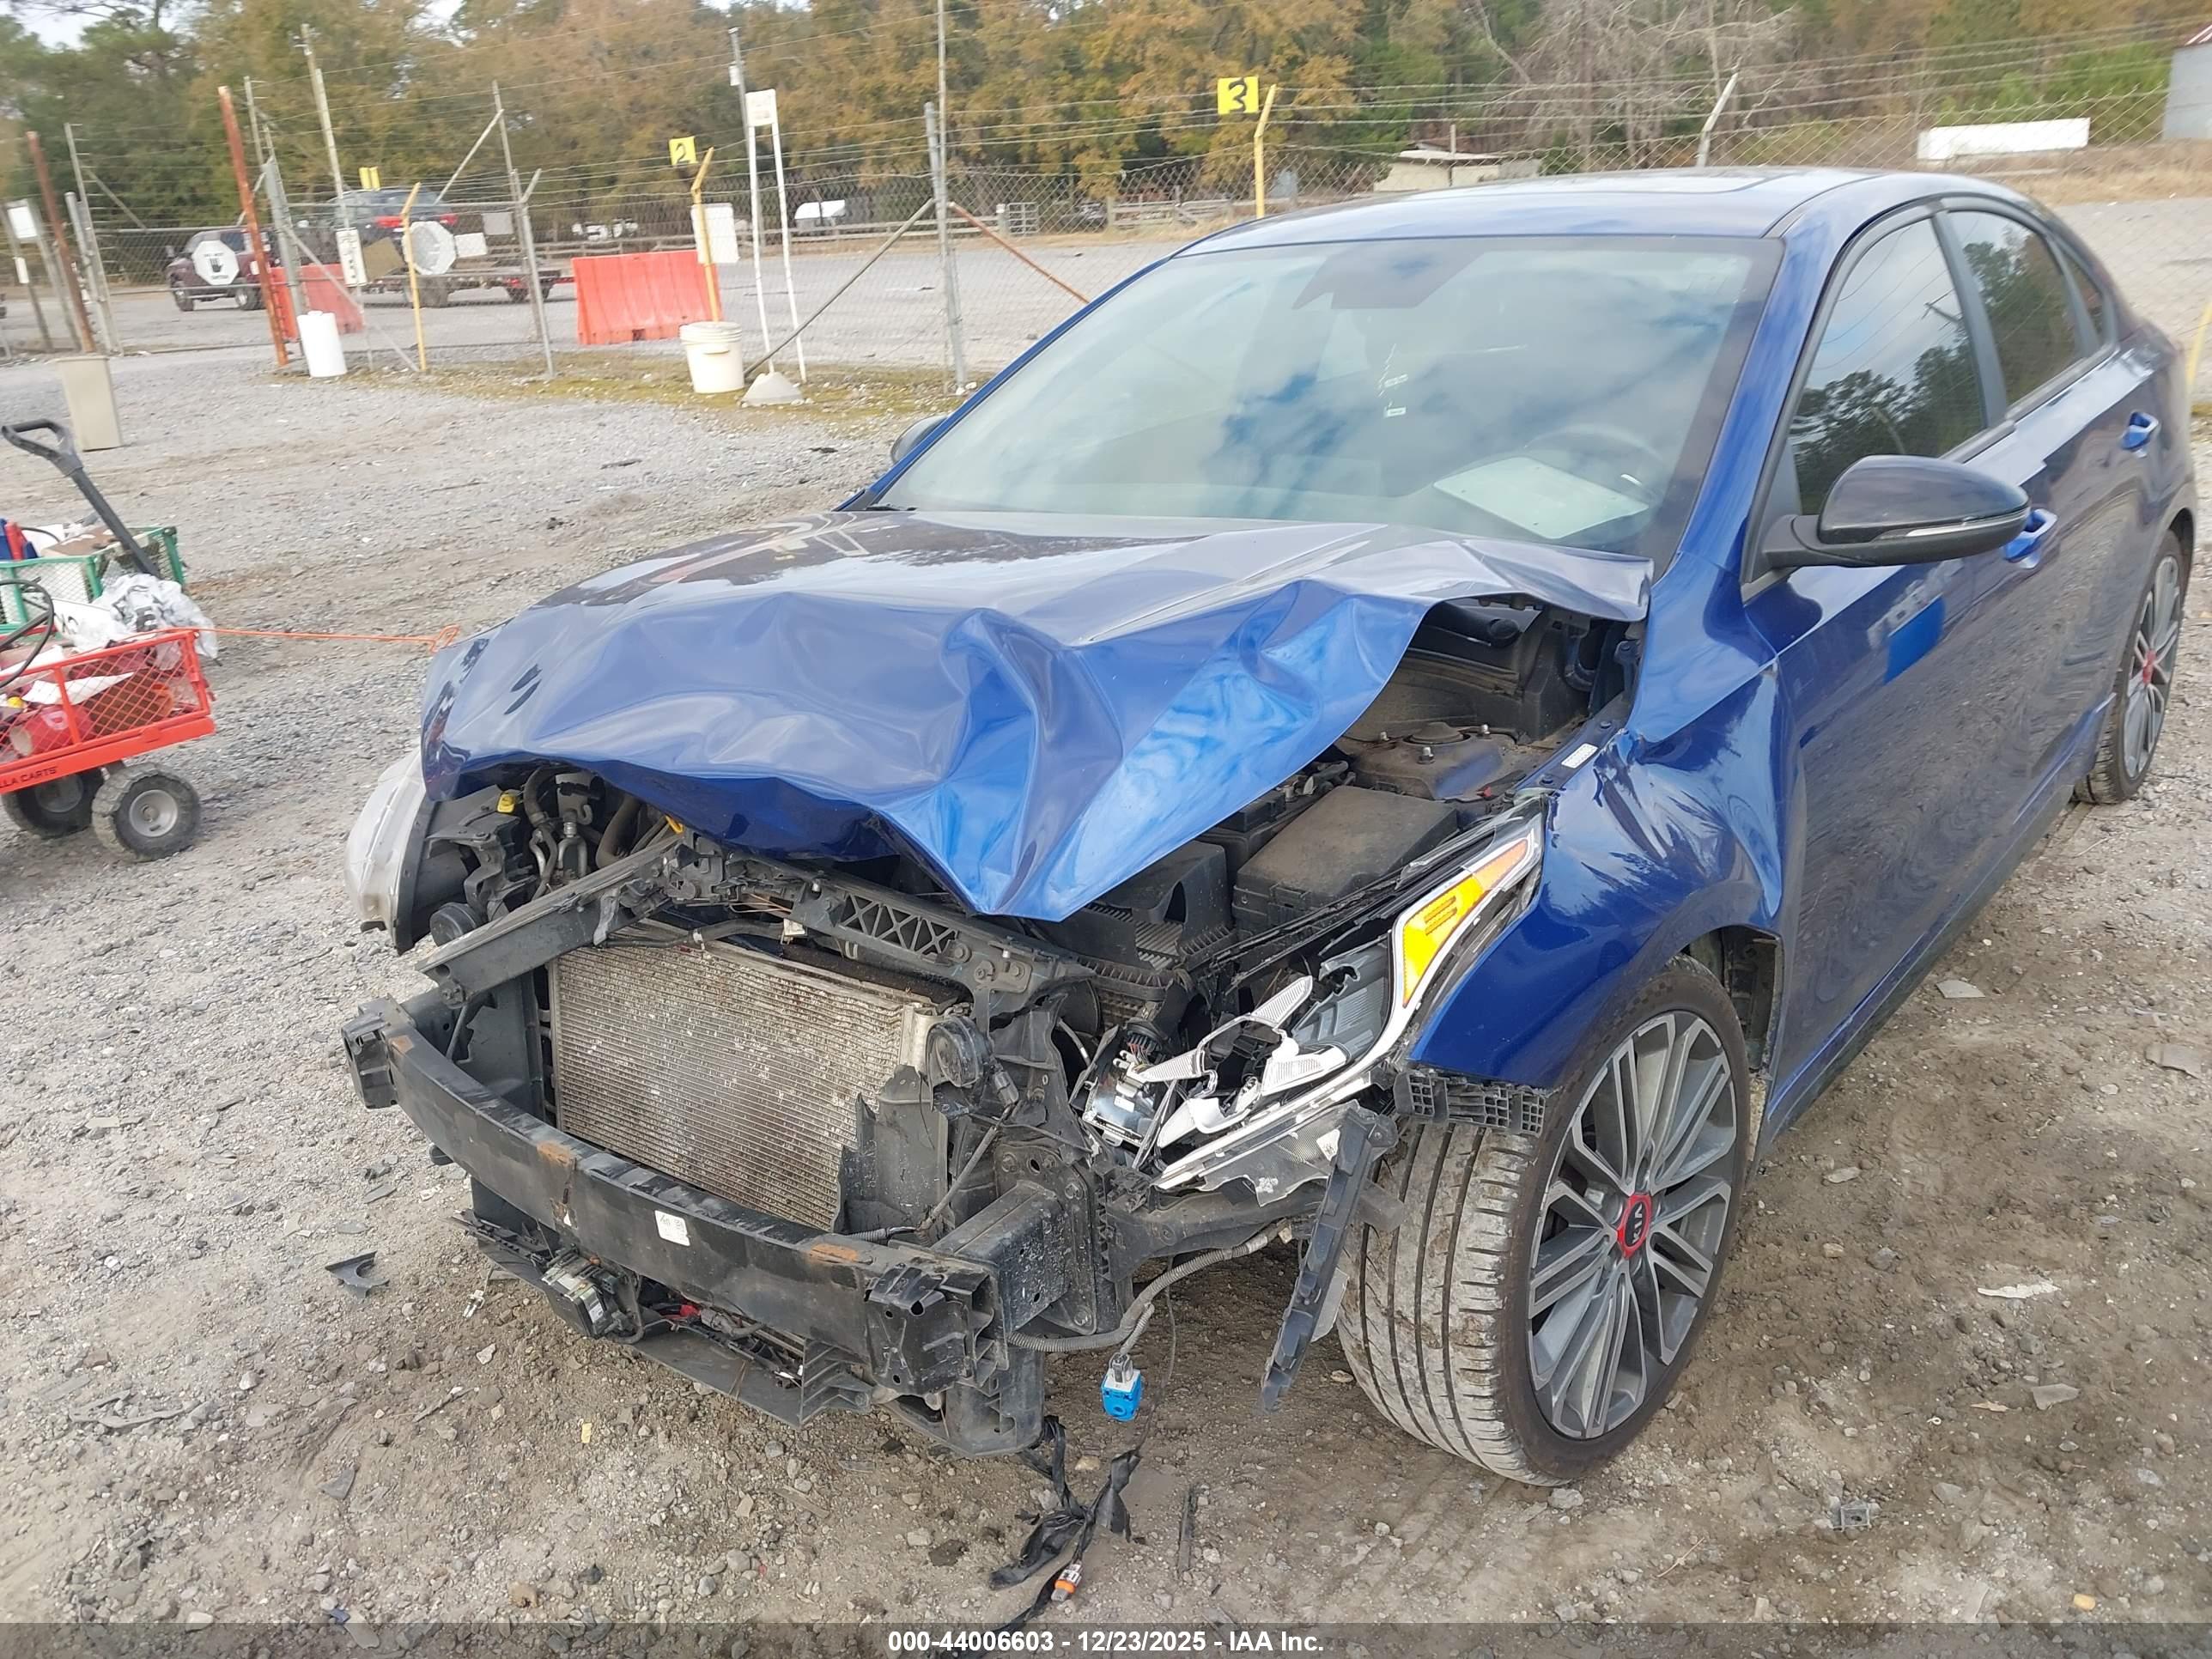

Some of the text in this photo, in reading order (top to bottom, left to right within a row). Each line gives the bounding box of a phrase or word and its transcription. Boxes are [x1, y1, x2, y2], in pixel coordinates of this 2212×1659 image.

[1228, 78, 1247, 112] 3
[675, 143, 690, 164] 2
[20, 766, 58, 782] CARTS
[1632, 1202, 1644, 1244] KIA
